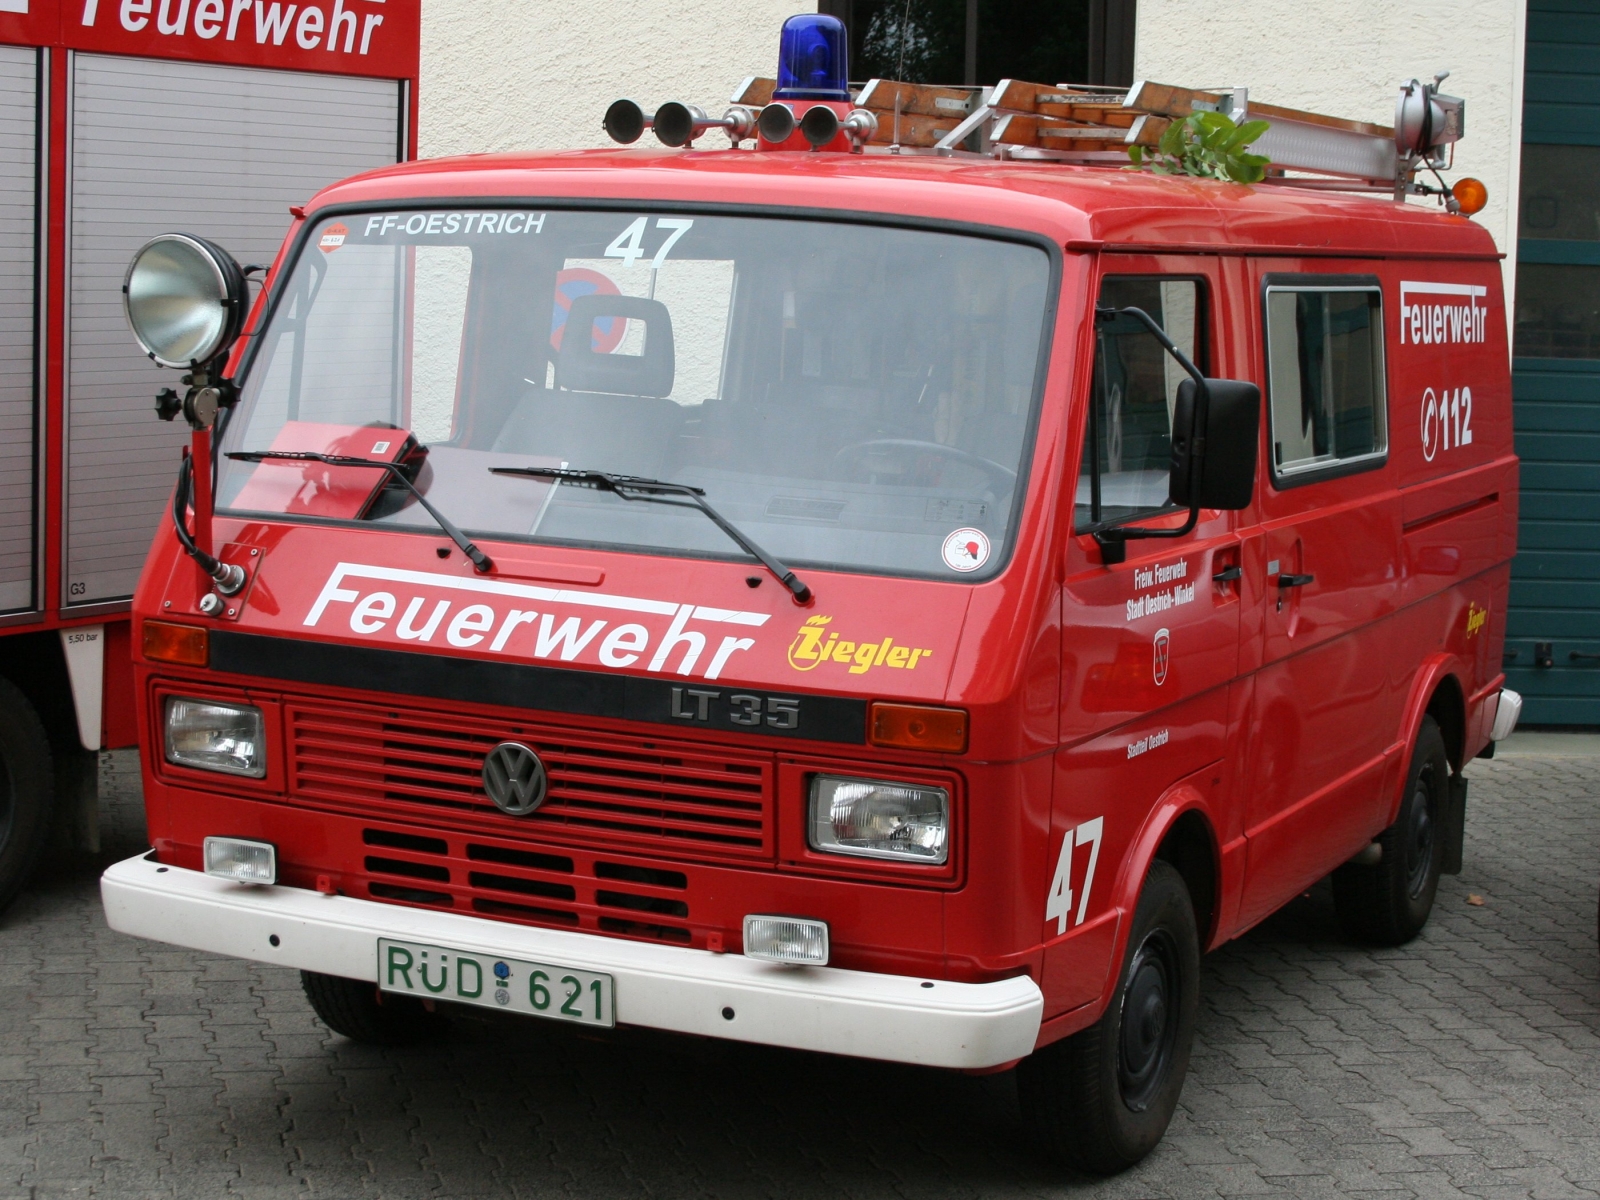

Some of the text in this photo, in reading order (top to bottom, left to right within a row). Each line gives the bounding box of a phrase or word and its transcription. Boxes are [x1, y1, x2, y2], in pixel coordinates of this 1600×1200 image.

[364, 213, 546, 236] FF-OESTRICH
[604, 216, 694, 269] 47
[1400, 281, 1487, 345] Feuerwehr
[1439, 386, 1473, 451] 112
[71, 583, 86, 595] G3
[1134, 557, 1187, 591] Freiw. Feuerwehr
[302, 562, 772, 680] Feuerwehr
[1126, 596, 1145, 621] Stadt
[68, 633, 98, 644] 5,50 bar
[788, 615, 932, 674] Ziegler
[671, 687, 800, 729] LT 35
[482, 742, 547, 816] VW
[1046, 815, 1104, 936] 47
[387, 945, 602, 1021] RÜD 621
